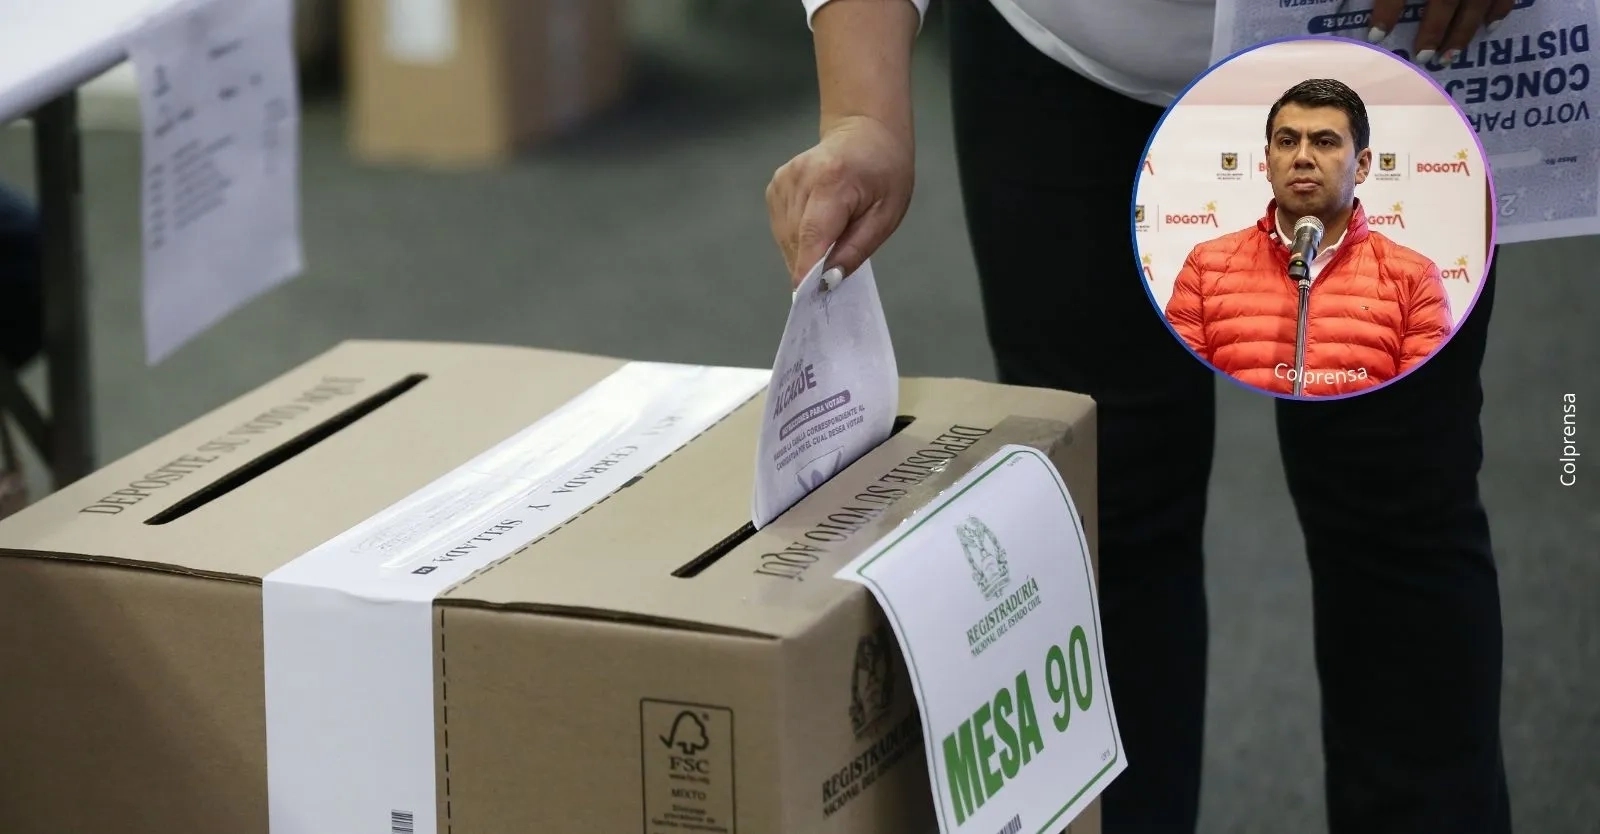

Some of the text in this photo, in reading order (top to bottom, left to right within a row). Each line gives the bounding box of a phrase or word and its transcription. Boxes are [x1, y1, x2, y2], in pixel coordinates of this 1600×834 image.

[1425, 24, 1589, 72] DISTRIT
[1445, 64, 1589, 104] CONCEJ
[1466, 101, 1590, 133] VOTO PAR
[806, 407, 858, 437] CORRESPONDIENTE
[858, 403, 865, 412] AL
[809, 404, 825, 417] PARA
[812, 433, 828, 446] CUAL
[828, 424, 846, 438] DESEA
[846, 415, 864, 428] VOTAR
[79, 453, 219, 516] DEPOSITE
[552, 445, 639, 495] CERRADA
[528, 503, 551, 512] Y
[753, 424, 993, 582] DEPOSITE SU VOTO AQUÍ
[432, 518, 523, 564] SELLADA
[966, 574, 1039, 647] REGISTRADURÍA
[971, 595, 1042, 657] NACIONAL DEL ESTADO CIVIL
[942, 625, 1093, 828] MESA 90
[669, 756, 710, 774] FSC
[672, 788, 706, 801] MIXTO
